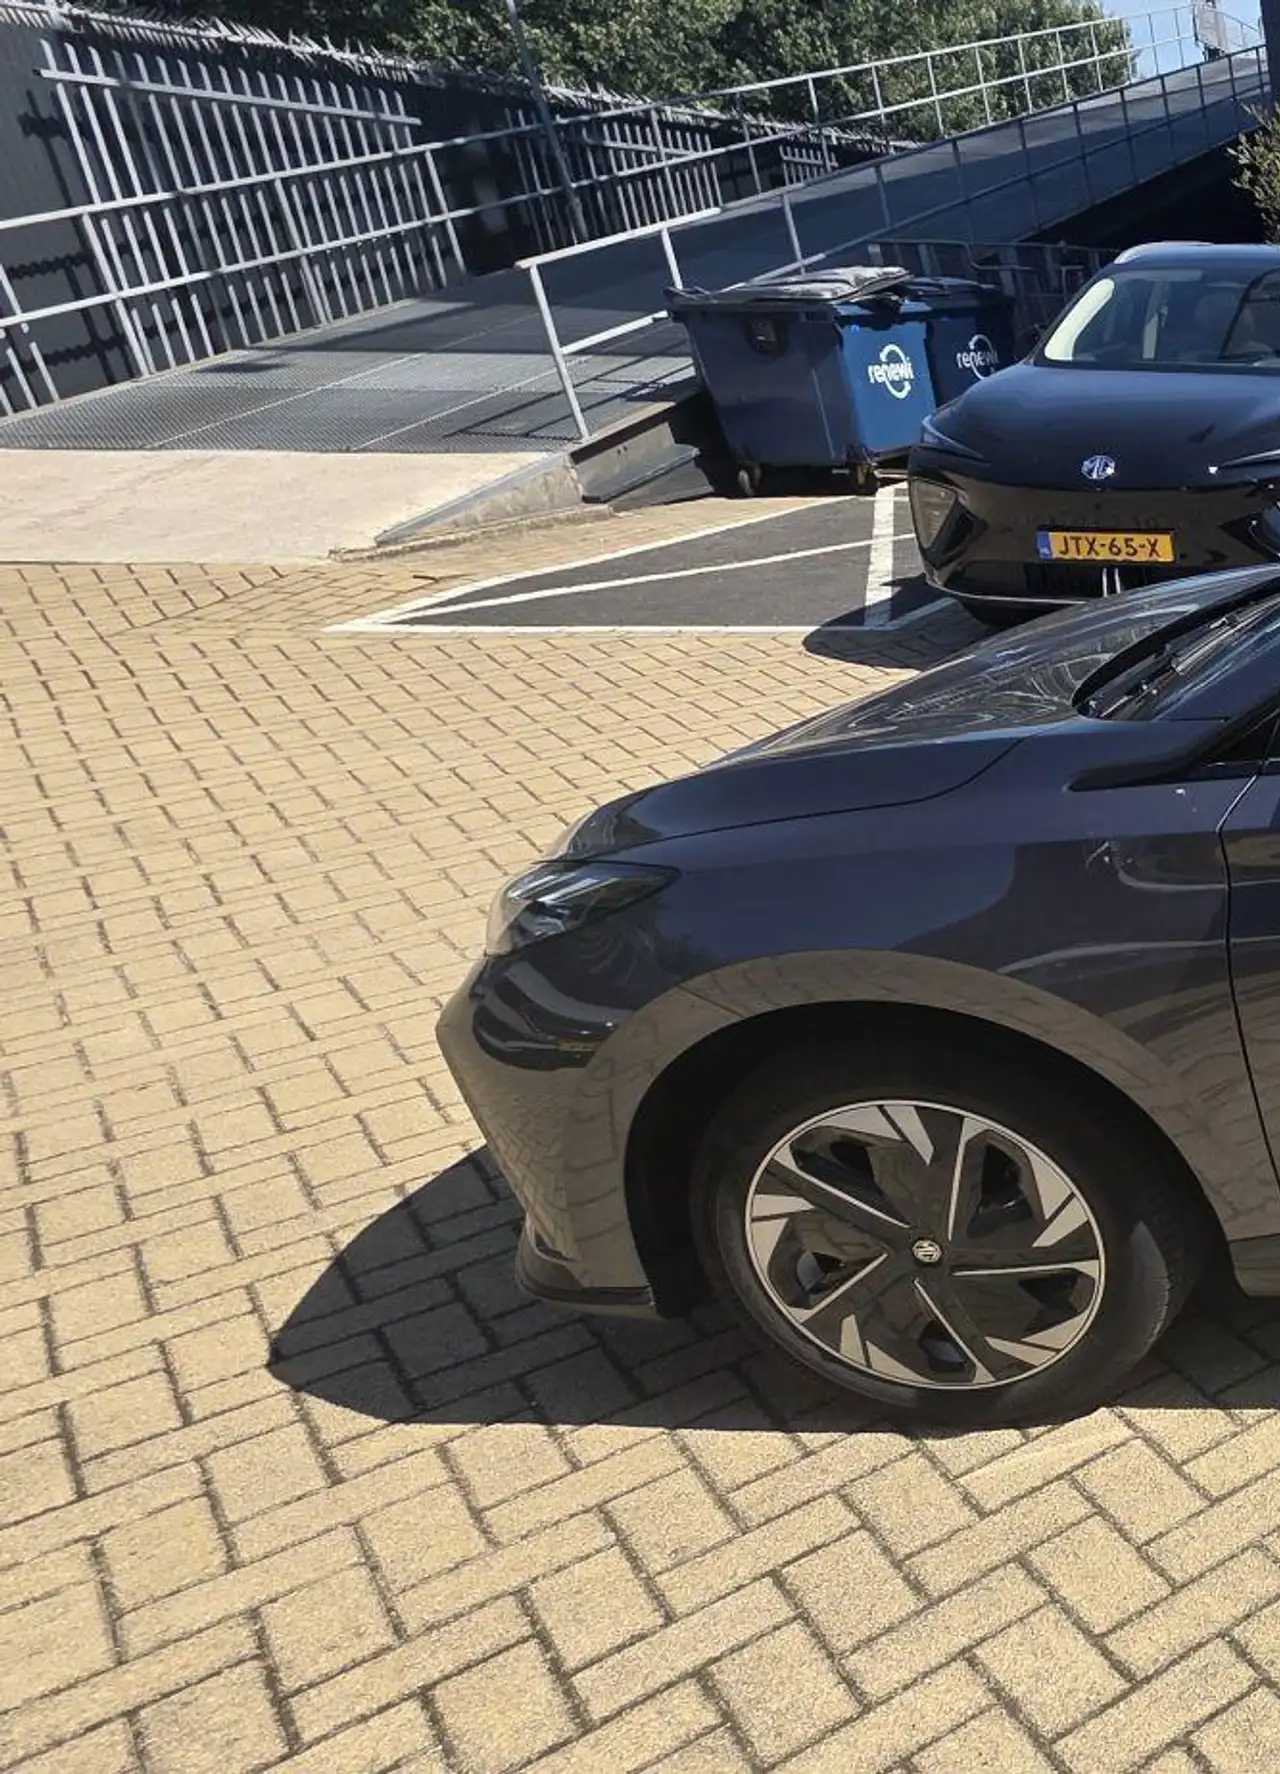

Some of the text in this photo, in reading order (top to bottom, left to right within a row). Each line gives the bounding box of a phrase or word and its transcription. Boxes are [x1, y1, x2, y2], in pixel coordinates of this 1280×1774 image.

[867, 356, 915, 384] renewi
[1081, 455, 1116, 480] MG
[1059, 535, 1164, 559] JTX-65-X
